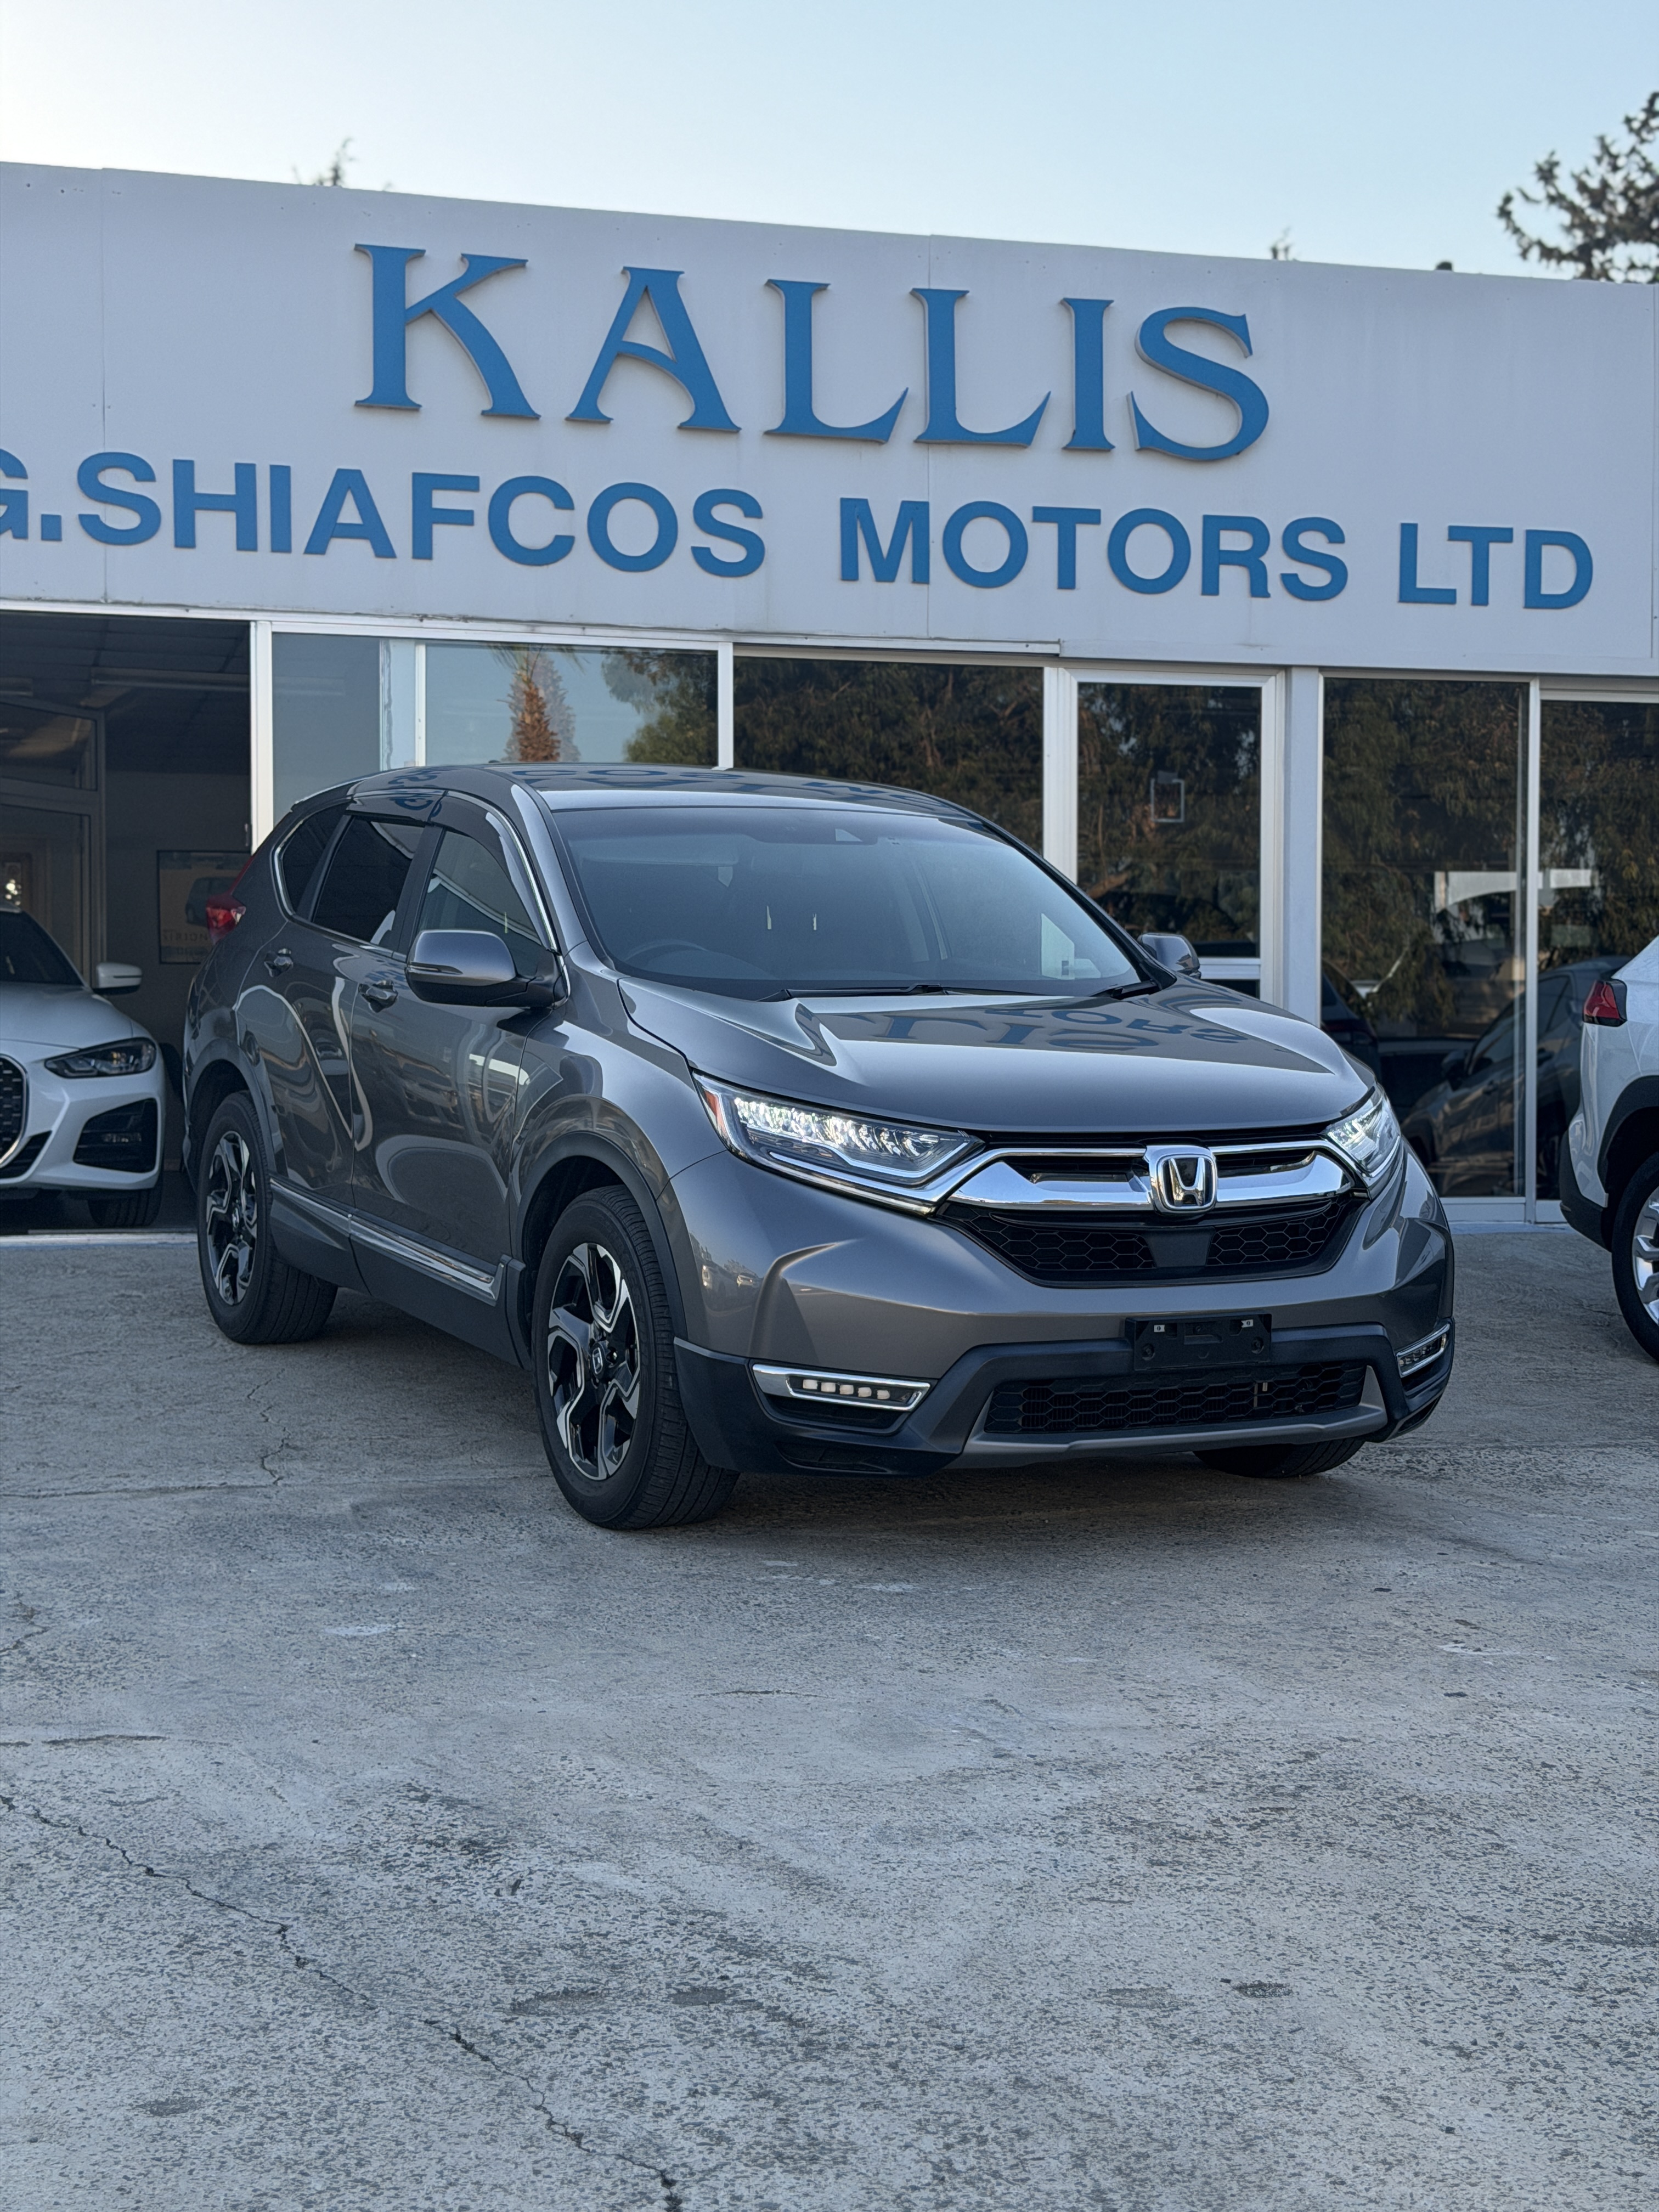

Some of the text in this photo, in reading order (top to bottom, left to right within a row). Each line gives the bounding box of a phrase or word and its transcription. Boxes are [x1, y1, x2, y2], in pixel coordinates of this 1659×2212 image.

[354, 243, 1269, 461] KALLIS
[840, 498, 1348, 602] MOTORS
[1398, 523, 1594, 610] LTD
